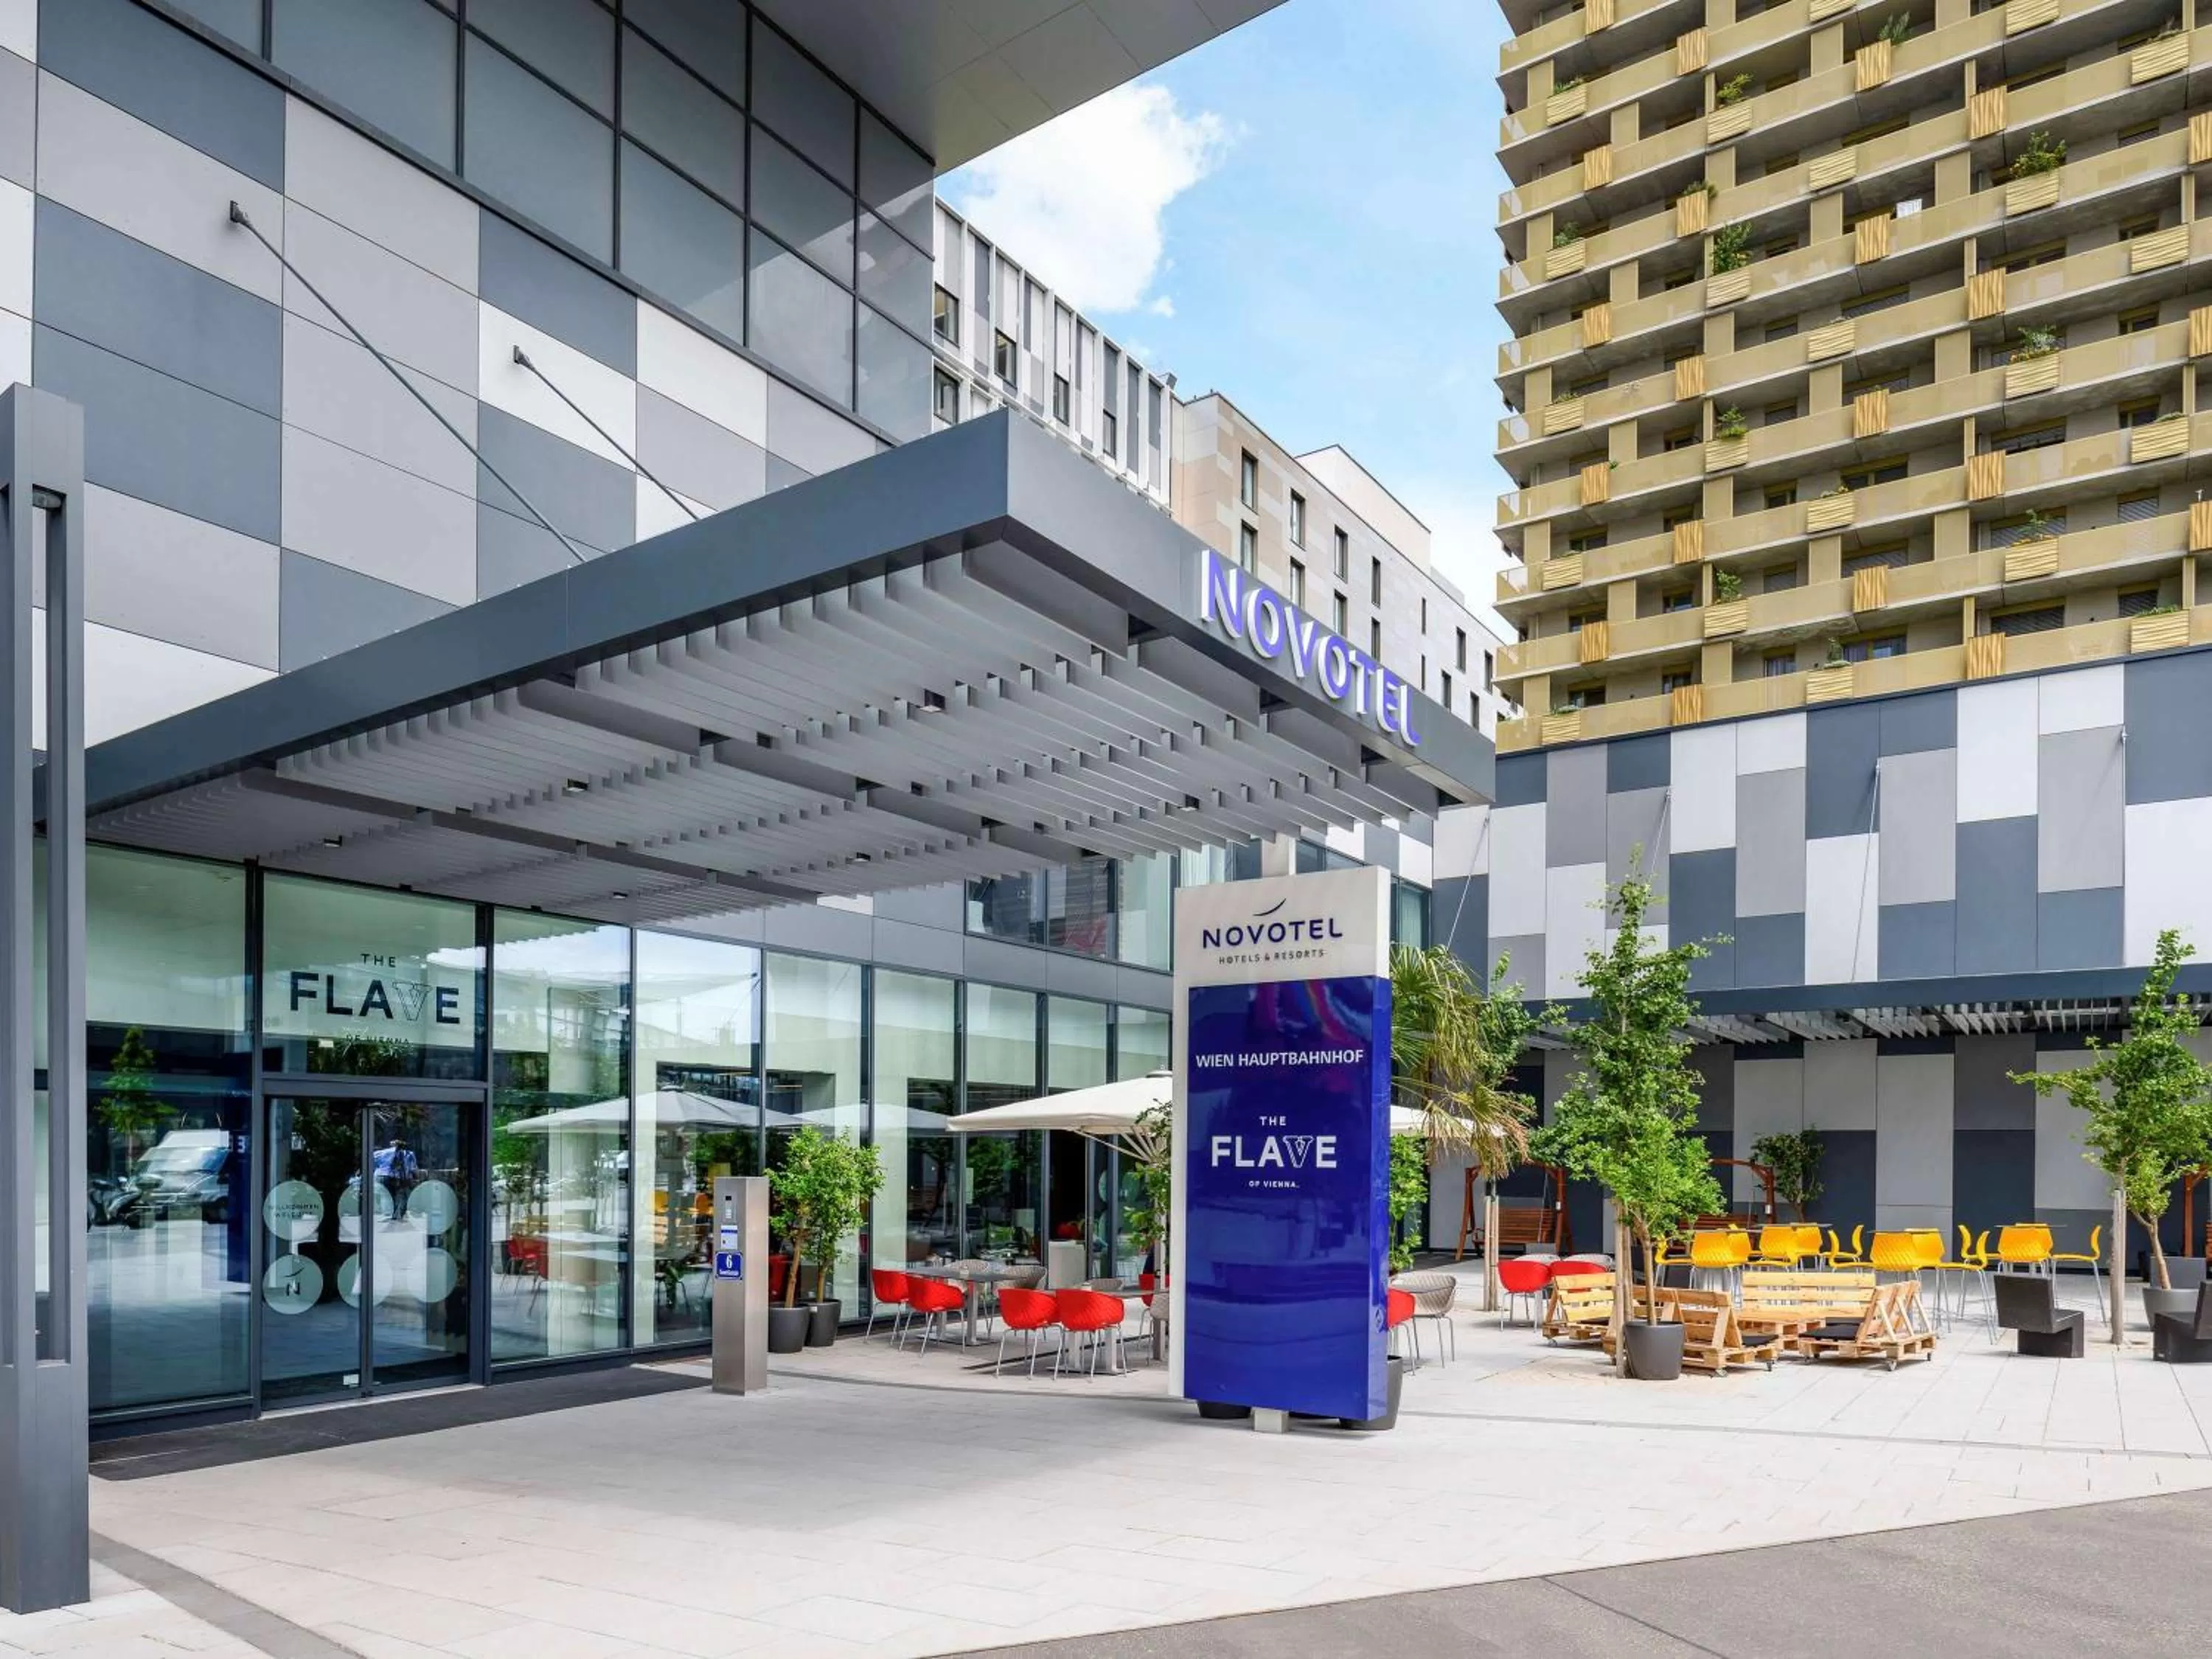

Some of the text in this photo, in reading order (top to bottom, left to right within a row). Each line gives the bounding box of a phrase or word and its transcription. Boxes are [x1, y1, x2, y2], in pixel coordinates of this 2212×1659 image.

[1201, 549, 1422, 746] NOVOTEL
[1203, 918, 1343, 949] NOVOTEL
[361, 953, 396, 968] THE
[1219, 949, 1324, 964] HOTELS & RESORTS
[291, 971, 460, 1023] FLAVE
[1196, 1049, 1363, 1068] WIEN HAUPTBAHNHOF
[1259, 1116, 1287, 1126] THE
[1211, 1135, 1337, 1169] FLAVE
[726, 1254, 732, 1268] 6
